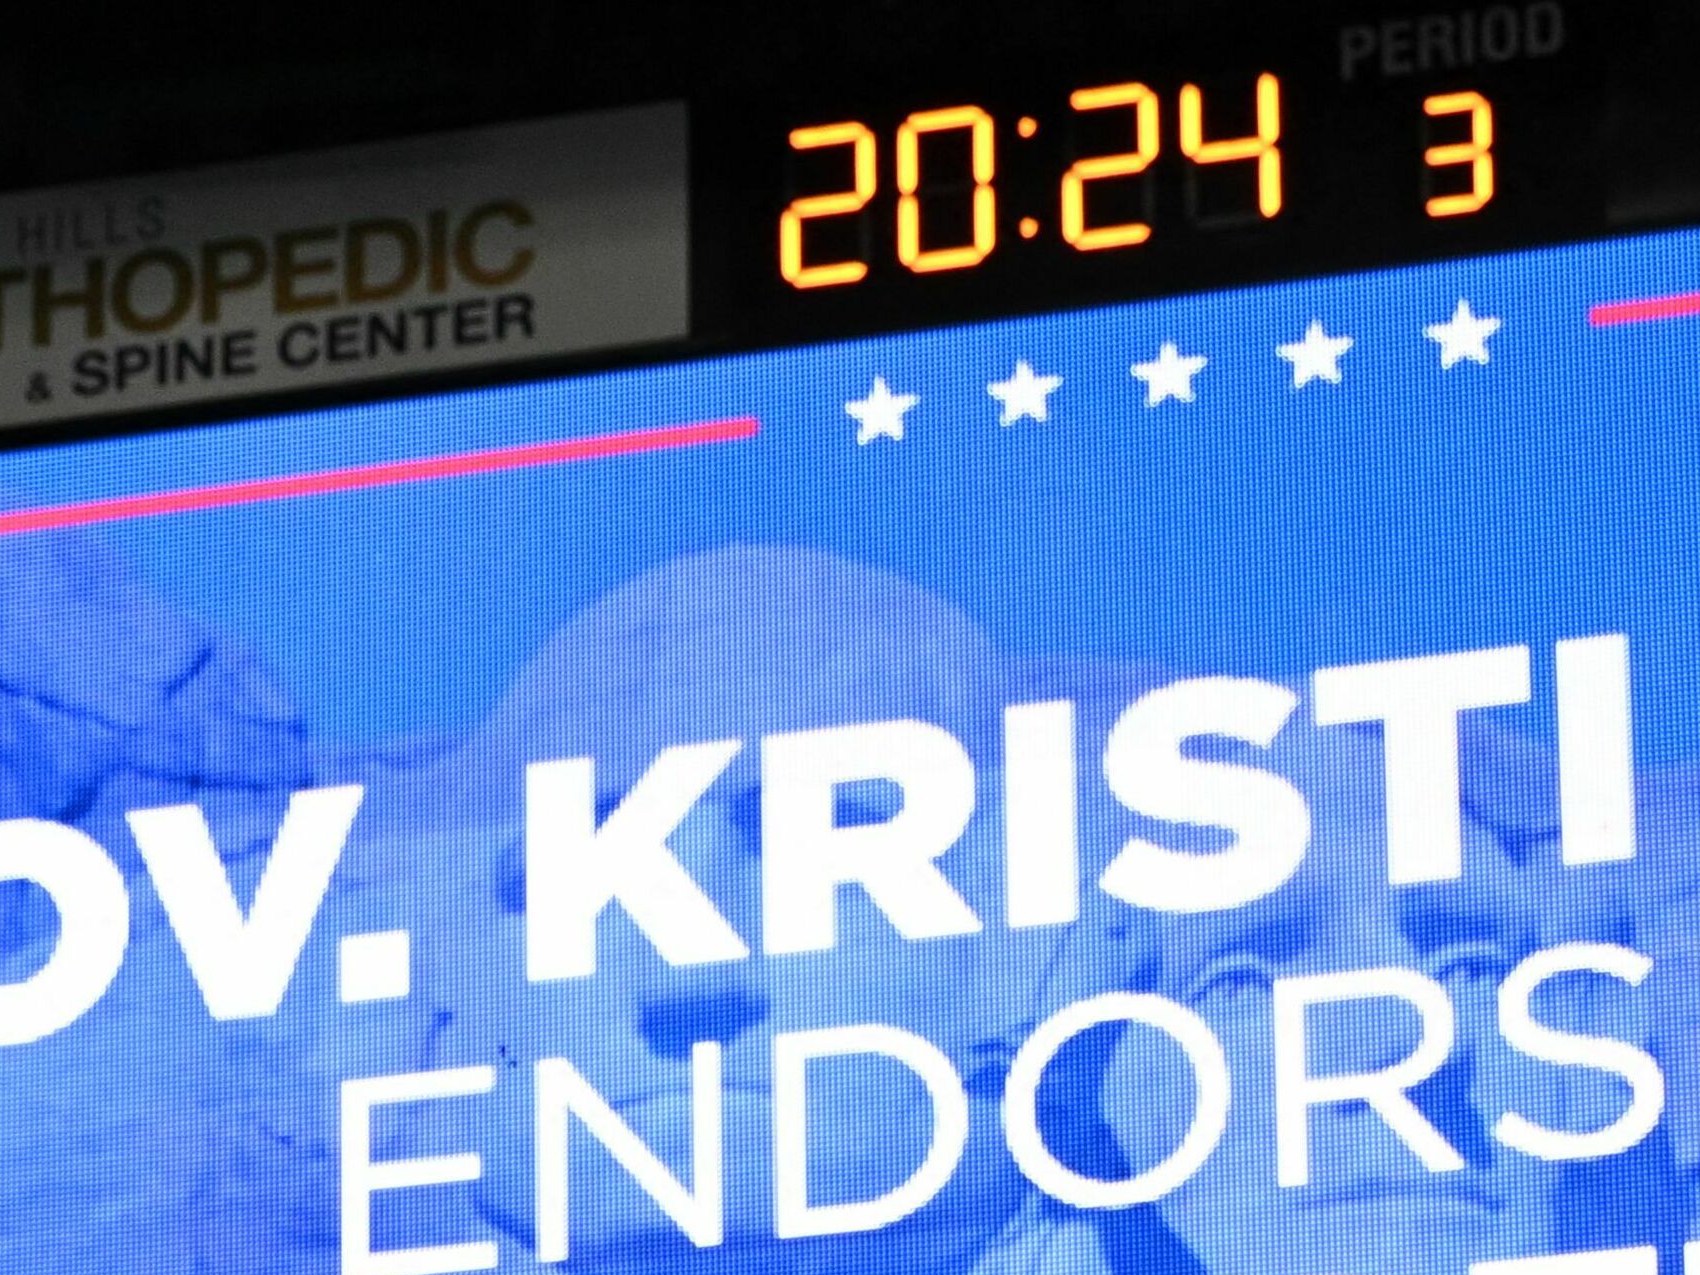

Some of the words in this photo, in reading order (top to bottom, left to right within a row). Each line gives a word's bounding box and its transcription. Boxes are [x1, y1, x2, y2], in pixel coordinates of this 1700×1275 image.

[1339, 1, 1566, 83] PERIOD
[779, 72, 1282, 289] 20:24
[1423, 91, 1494, 218] 3
[17, 197, 167, 260] HILLS
[27, 371, 51, 404] &
[73, 331, 255, 398] SPINE
[278, 293, 535, 369] CENTER
[527, 635, 1635, 981] KRISTI
